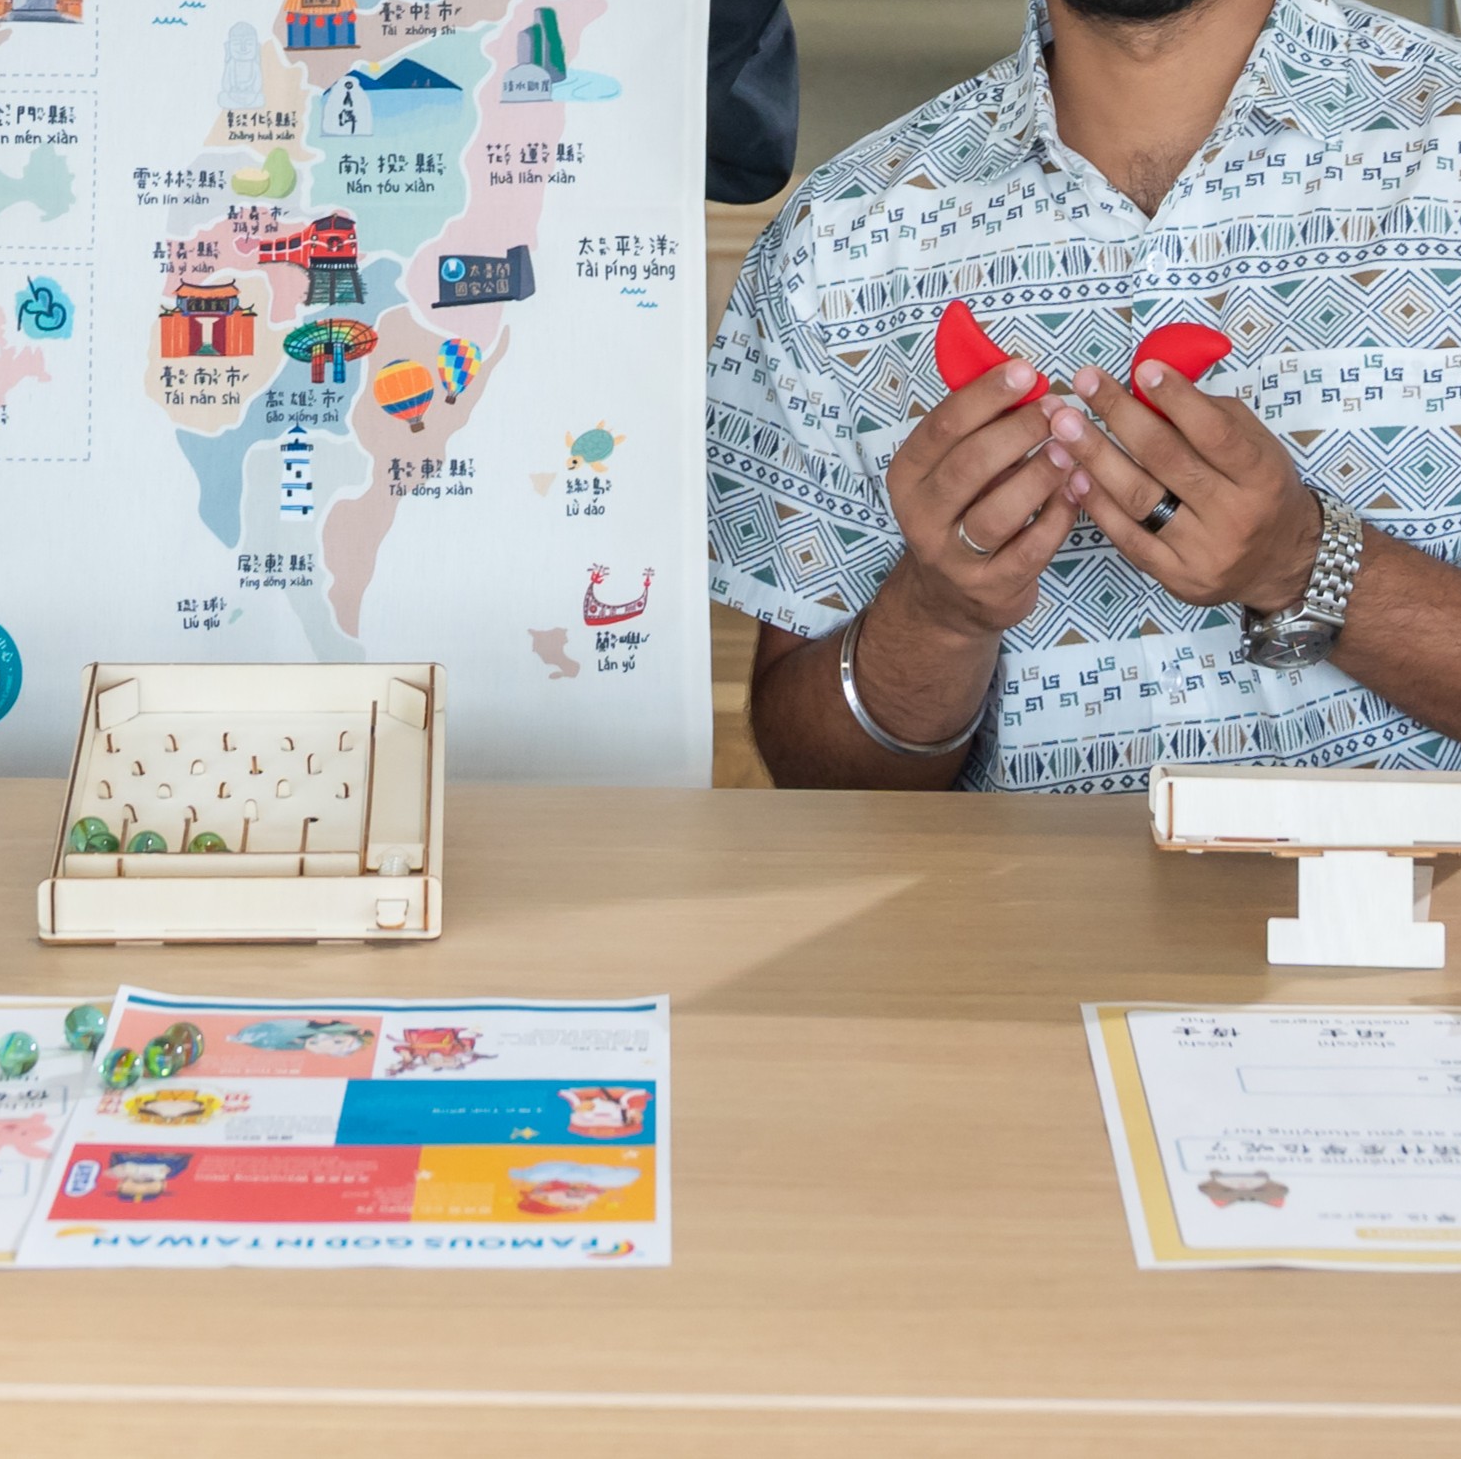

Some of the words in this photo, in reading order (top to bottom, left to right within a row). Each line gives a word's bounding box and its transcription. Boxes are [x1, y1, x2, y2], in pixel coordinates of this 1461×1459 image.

[92, 1236, 264, 1250] TAIWAN
[324, 1237, 413, 1250] GOD
[425, 1237, 598, 1250] FAMOUS
